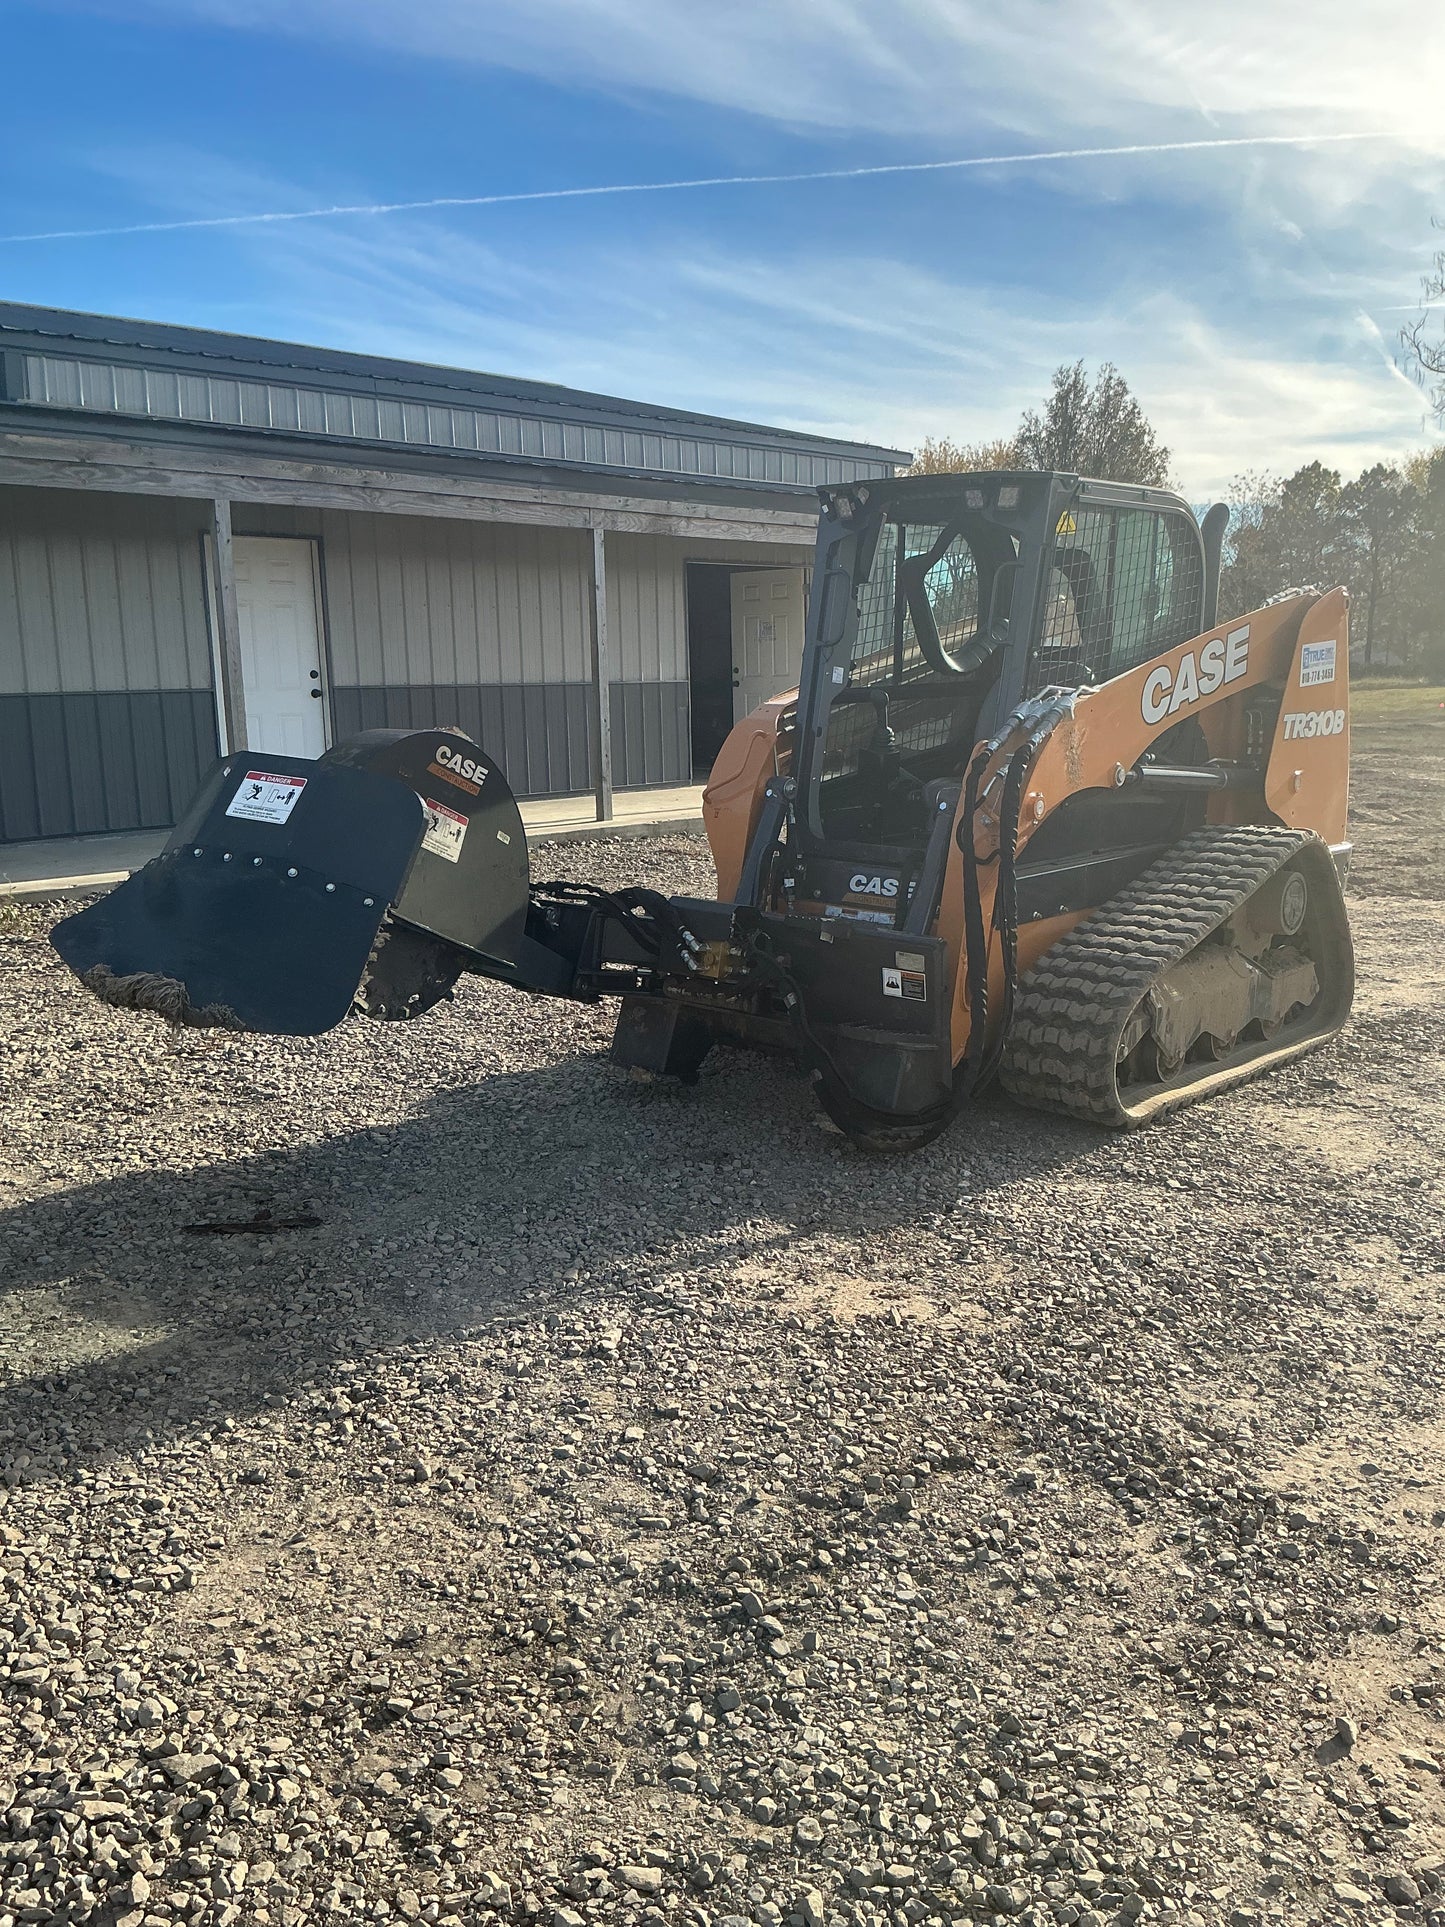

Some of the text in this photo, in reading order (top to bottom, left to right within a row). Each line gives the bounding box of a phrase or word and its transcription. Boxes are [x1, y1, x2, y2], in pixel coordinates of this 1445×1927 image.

[1309, 648, 1325, 663] TRUE
[1141, 623, 1250, 725] CASE
[1283, 709, 1346, 740] TR310B
[435, 745, 489, 786] CASE
[266, 776, 292, 785] DANGER
[436, 767, 479, 794] CONSTRUCTION
[440, 807, 459, 820] DANGER
